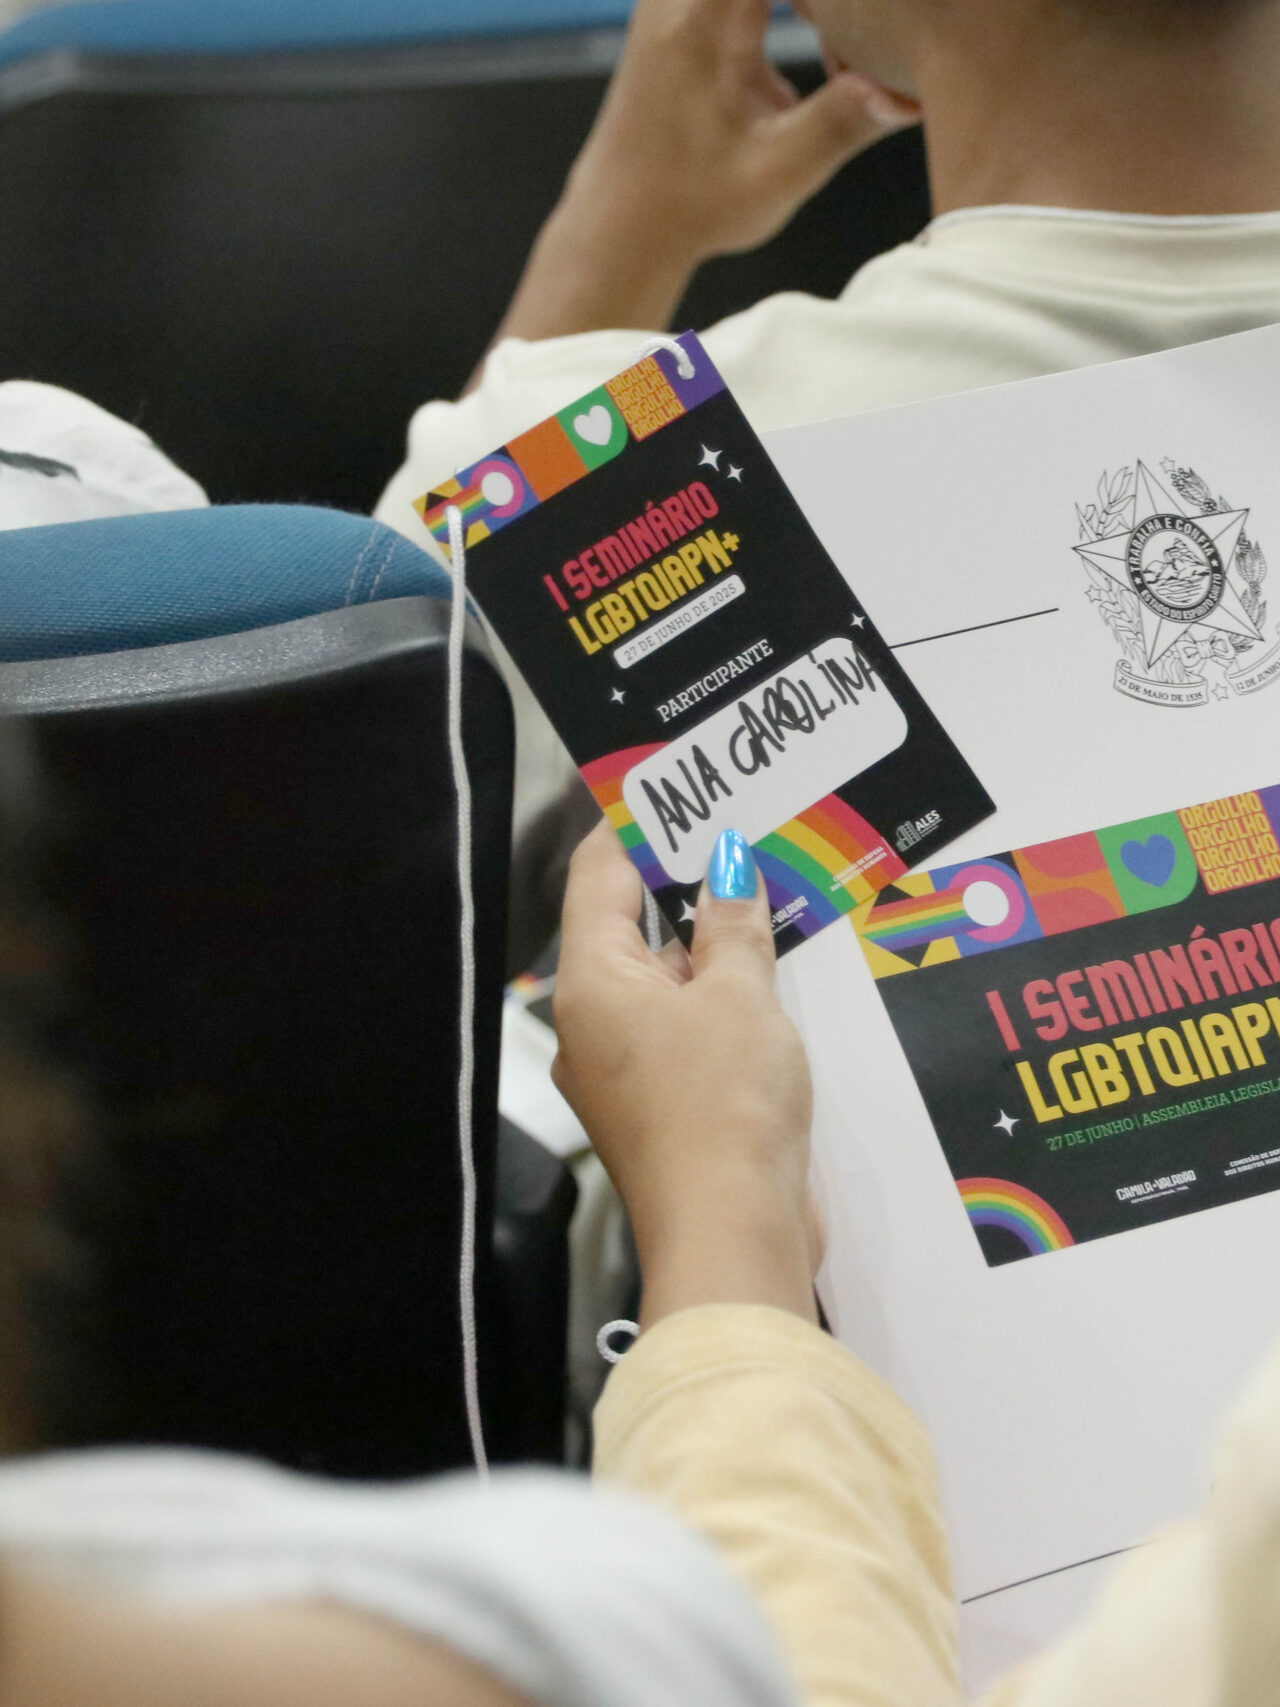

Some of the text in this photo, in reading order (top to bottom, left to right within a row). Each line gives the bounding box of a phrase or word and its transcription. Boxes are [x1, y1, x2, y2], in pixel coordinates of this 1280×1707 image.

[615, 370, 668, 410] ORGULHO
[624, 385, 676, 425] ORGULHO
[633, 399, 685, 439] ORGULHO
[543, 481, 720, 612] I SEMINÁRIO
[1129, 517, 1214, 572] TRABALHA E CONFIA
[568, 529, 740, 655] LGBTQIAPN+
[1141, 589, 1170, 616] ESTADO
[1170, 609, 1183, 619] DO
[1208, 573, 1222, 600] SANTO
[623, 583, 737, 661] 27 DE JUNHO DE 2025
[656, 638, 774, 722] PARTICIPANTE
[1128, 682, 1141, 693] DE
[1142, 688, 1169, 700] MAIO
[1170, 693, 1184, 702] DE
[1244, 678, 1257, 687] DE
[1256, 661, 1280, 682] JUNHO
[640, 744, 733, 853] ANA
[1179, 792, 1263, 829] ORGULHO
[915, 810, 940, 831] ALES
[1187, 812, 1271, 850] ORGULHO
[1196, 833, 1280, 871] ORGULHO
[985, 990, 1021, 1051] I
[1046, 1135, 1063, 1151] 27
[1064, 1129, 1086, 1147] DE
[1084, 1118, 1134, 1145] JUNHO
[1142, 1094, 1231, 1127] ASSEMBLEIA
[1224, 1167, 1238, 1176] DOS
[1261, 1151, 1269, 1159] DE
